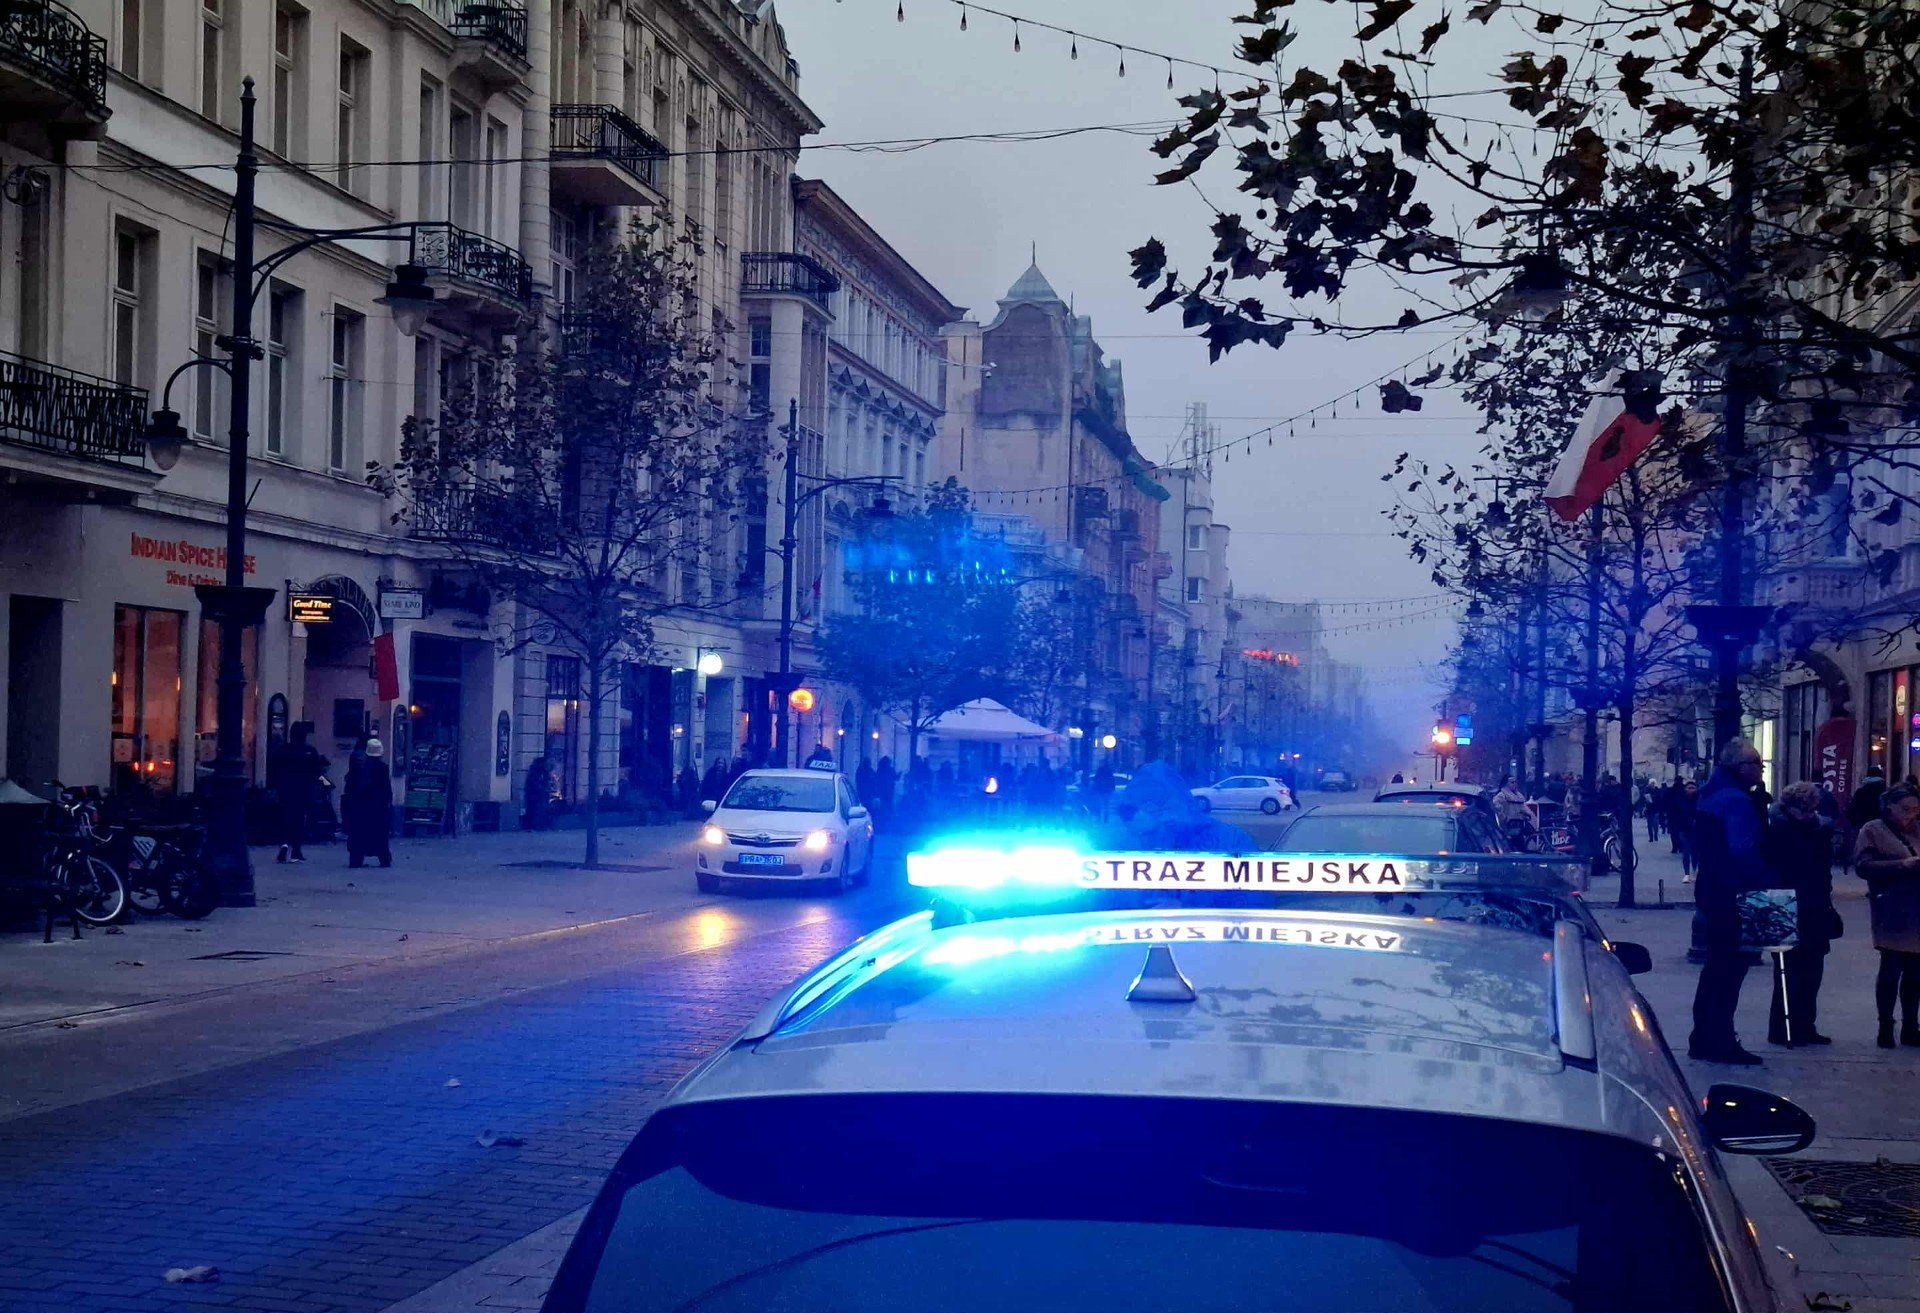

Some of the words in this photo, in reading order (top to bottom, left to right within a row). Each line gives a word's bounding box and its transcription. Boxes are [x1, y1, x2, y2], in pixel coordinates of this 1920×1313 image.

[131, 531, 177, 562] INDIAN
[179, 540, 214, 568] SPICE
[217, 546, 256, 574] HSE
[1823, 744, 1837, 792] OSTA
[1838, 759, 1848, 793] COFFEE
[1223, 860, 1401, 885] MIEJSKA
